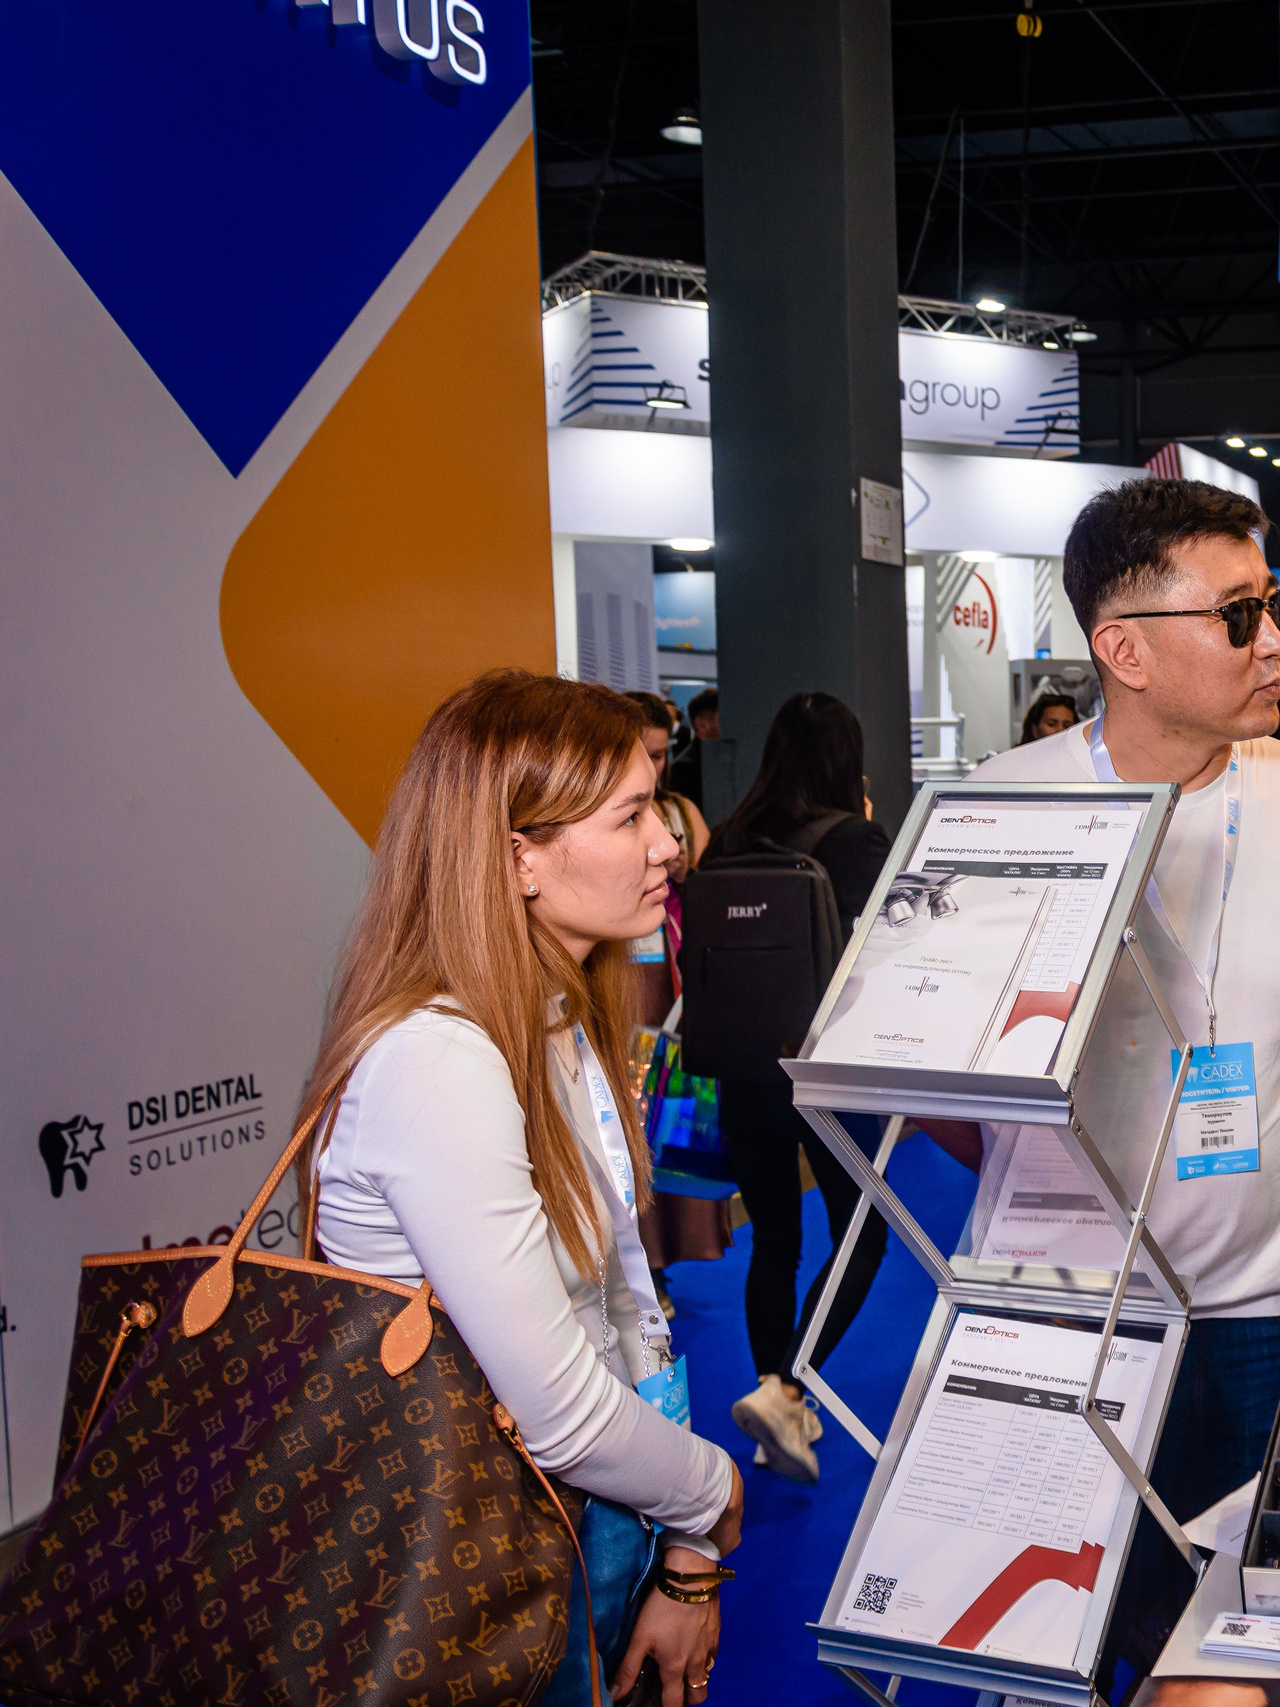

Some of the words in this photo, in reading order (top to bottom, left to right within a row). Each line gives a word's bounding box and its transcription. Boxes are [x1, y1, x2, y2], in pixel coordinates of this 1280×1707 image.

[953, 602, 989, 630] cefla
[927, 846, 1002, 856] Коммерческое
[1004, 847, 1075, 856] предложение
[727, 905, 764, 920] JERRY
[873, 1033, 925, 1044] DENTOPTICS
[1201, 1064, 1244, 1080] CADEX
[1226, 1085, 1250, 1094] VISITOR
[127, 1095, 168, 1131] DSI
[175, 1073, 263, 1119] DENTAL
[129, 1120, 266, 1176] SOLUTIONS
[964, 1325, 1020, 1340] DENTOPTICS
[950, 1359, 1023, 1378] Коммерческое
[1024, 1371, 1089, 1389] предложени
